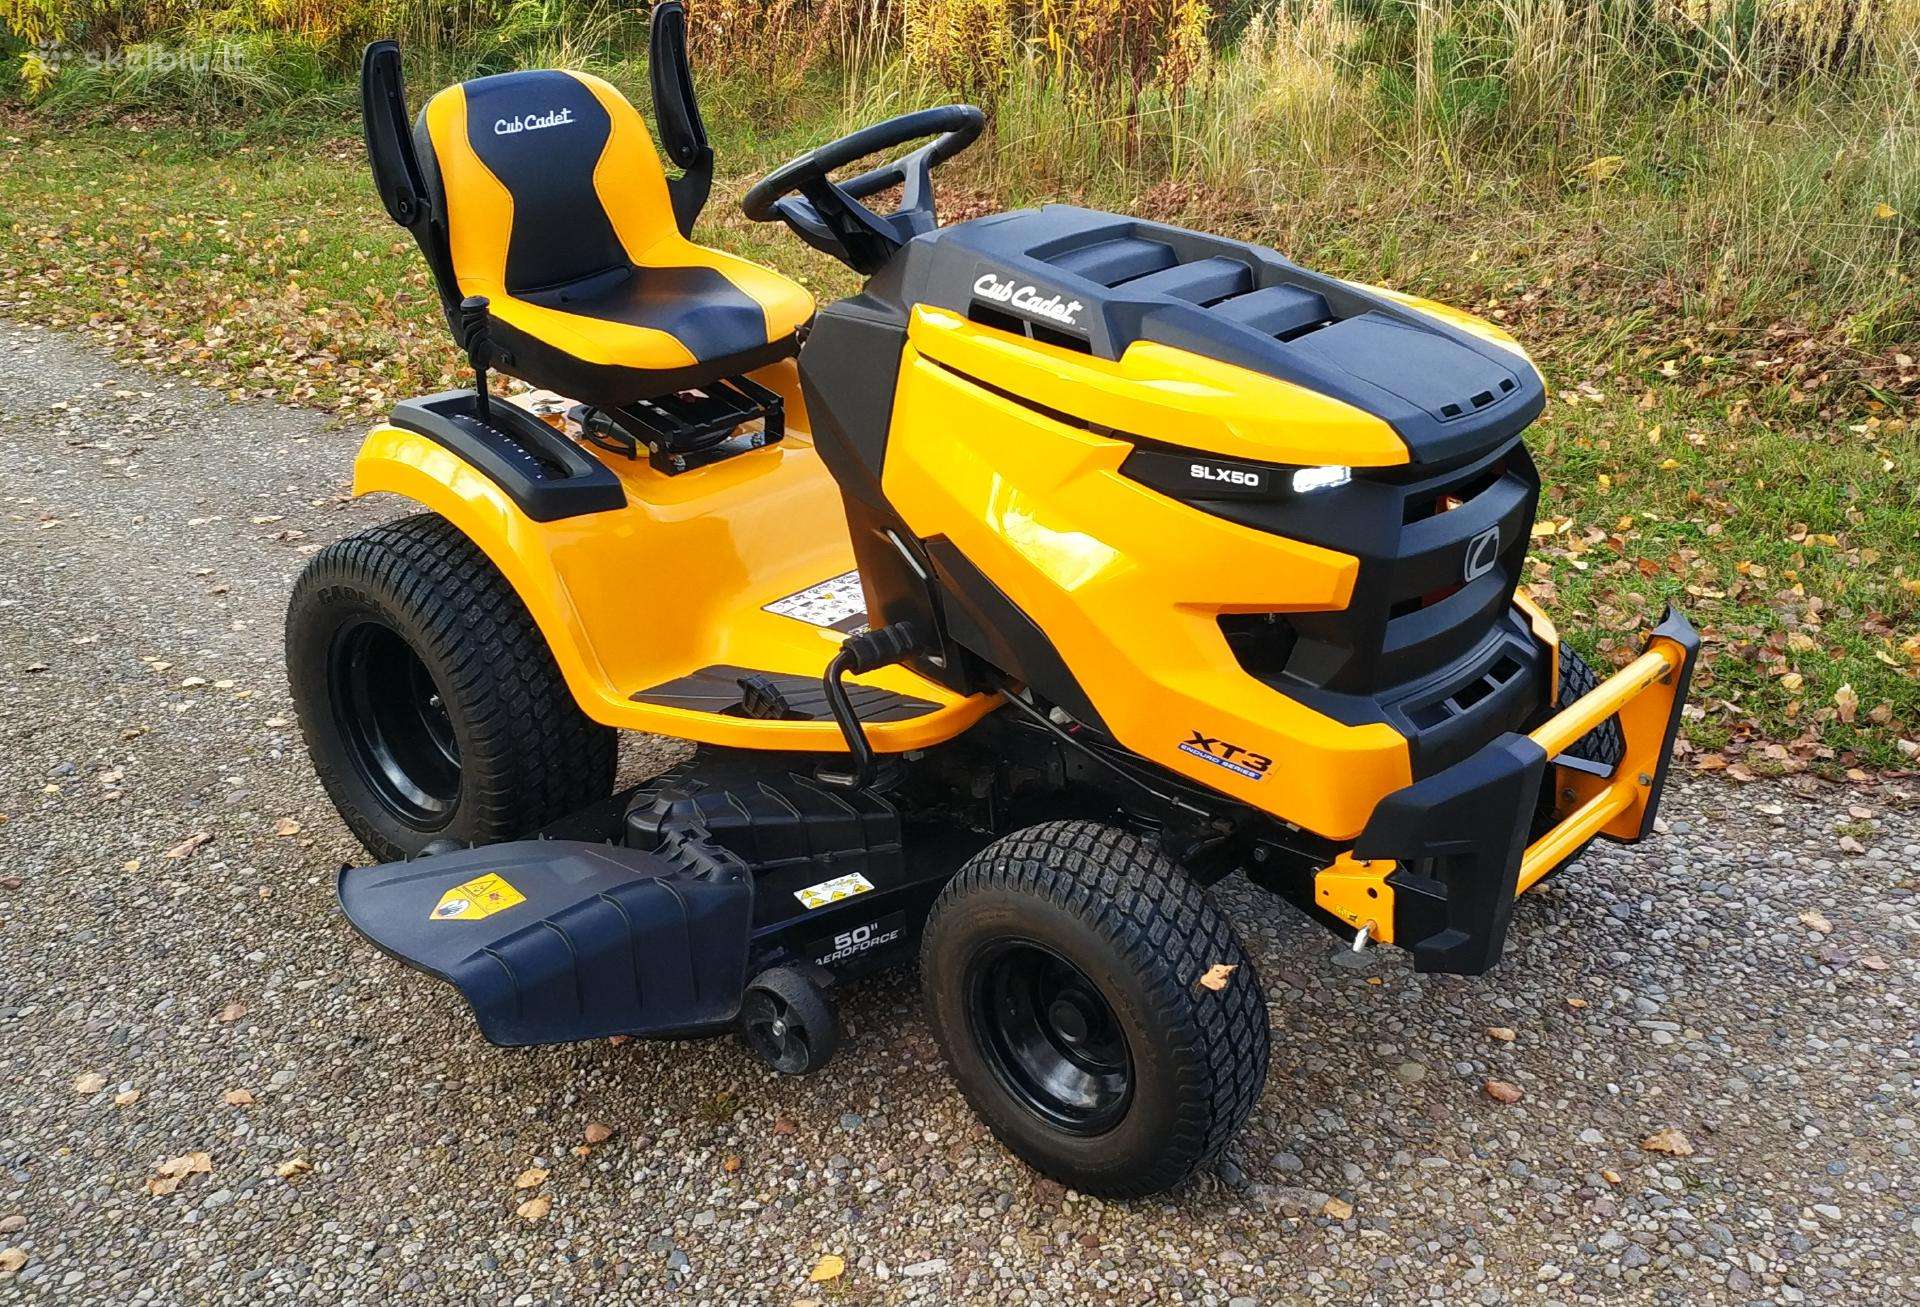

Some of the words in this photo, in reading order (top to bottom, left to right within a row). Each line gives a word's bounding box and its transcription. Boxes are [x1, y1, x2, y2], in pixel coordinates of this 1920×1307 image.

[494, 116, 524, 135] Cub
[524, 108, 574, 130] Cadet
[973, 273, 1015, 302] Cub
[1011, 285, 1083, 325] Cadet
[1190, 464, 1259, 487] SLX50
[1183, 729, 1273, 772] XT3
